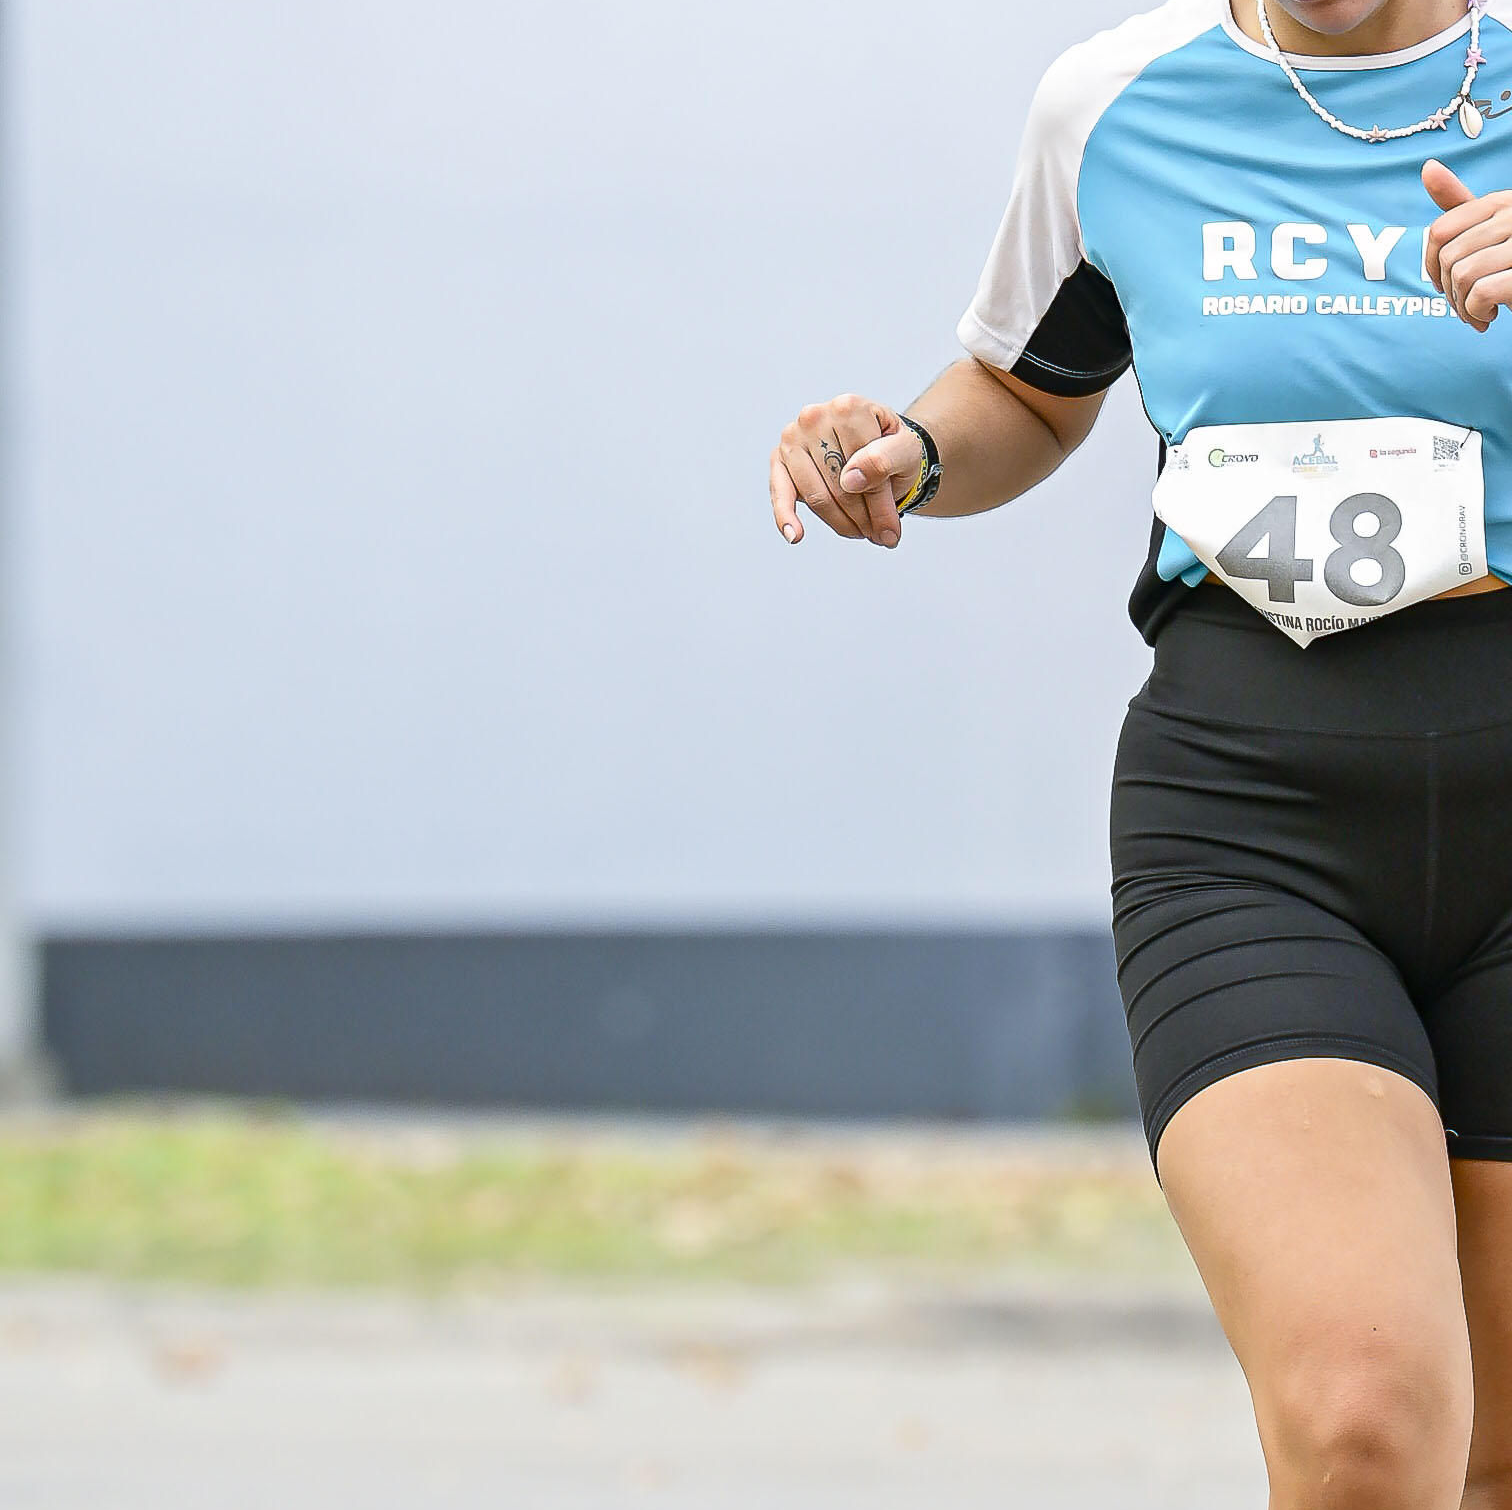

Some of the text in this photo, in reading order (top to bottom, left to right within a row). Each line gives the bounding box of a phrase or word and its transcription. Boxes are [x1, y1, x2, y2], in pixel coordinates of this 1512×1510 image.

[1202, 220, 1432, 282] RCY
[1202, 295, 1459, 318] ROSARIO CALLEYPIS
[1215, 492, 1406, 606] 48
[1306, 615, 1345, 632] ROCÍO
